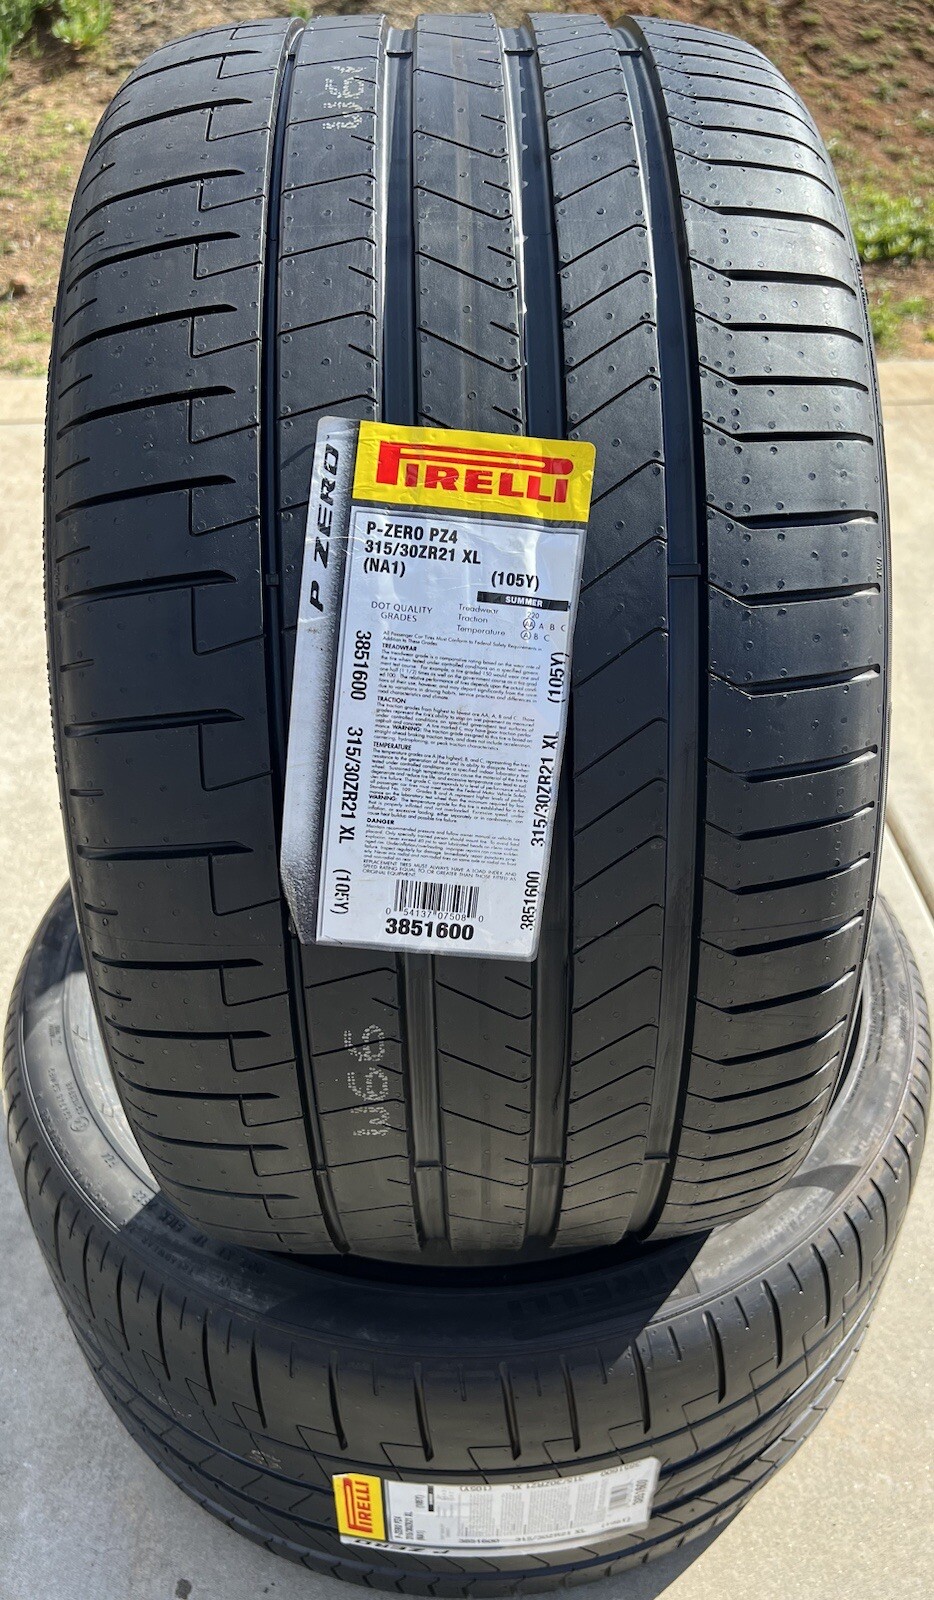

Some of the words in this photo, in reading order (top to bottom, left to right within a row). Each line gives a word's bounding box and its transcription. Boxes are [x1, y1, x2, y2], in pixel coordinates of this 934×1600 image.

[376, 440, 574, 503] PIRELLI
[314, 443, 339, 569] ZERO
[366, 521, 424, 541] P-ZERO
[429, 527, 458, 544] PZ4
[365, 540, 455, 562] 315/30ZR21
[462, 549, 481, 565] XL
[363, 557, 405, 578] (NA1)
[491, 571, 540, 592] (105Y)
[310, 580, 324, 612] P
[505, 595, 544, 608] SUMMER
[371, 601, 390, 611] DOT
[393, 603, 433, 615] QUALITY
[380, 611, 418, 623] GRADES
[457, 614, 489, 624] Traction
[458, 603, 499, 615] Treadwear
[456, 625, 506, 637] Temperature
[381, 642, 416, 651] TREADWEAR
[350, 629, 372, 701] 3851600
[547, 651, 570, 704] (105Y)
[377, 695, 406, 703] TRACTION
[373, 741, 411, 750] TEMPERATURE
[340, 726, 363, 821] 315/30ZR21
[530, 756, 555, 848] 315/30ZR21
[338, 825, 355, 844] XL
[330, 869, 352, 915] (105Y)
[520, 870, 541, 931] 3851600
[403, 909, 432, 918] 54137
[438, 912, 467, 922] 07508
[478, 914, 484, 922] 0
[385, 917, 474, 940] 3851600
[342, 1477, 374, 1534] PIRELLI
